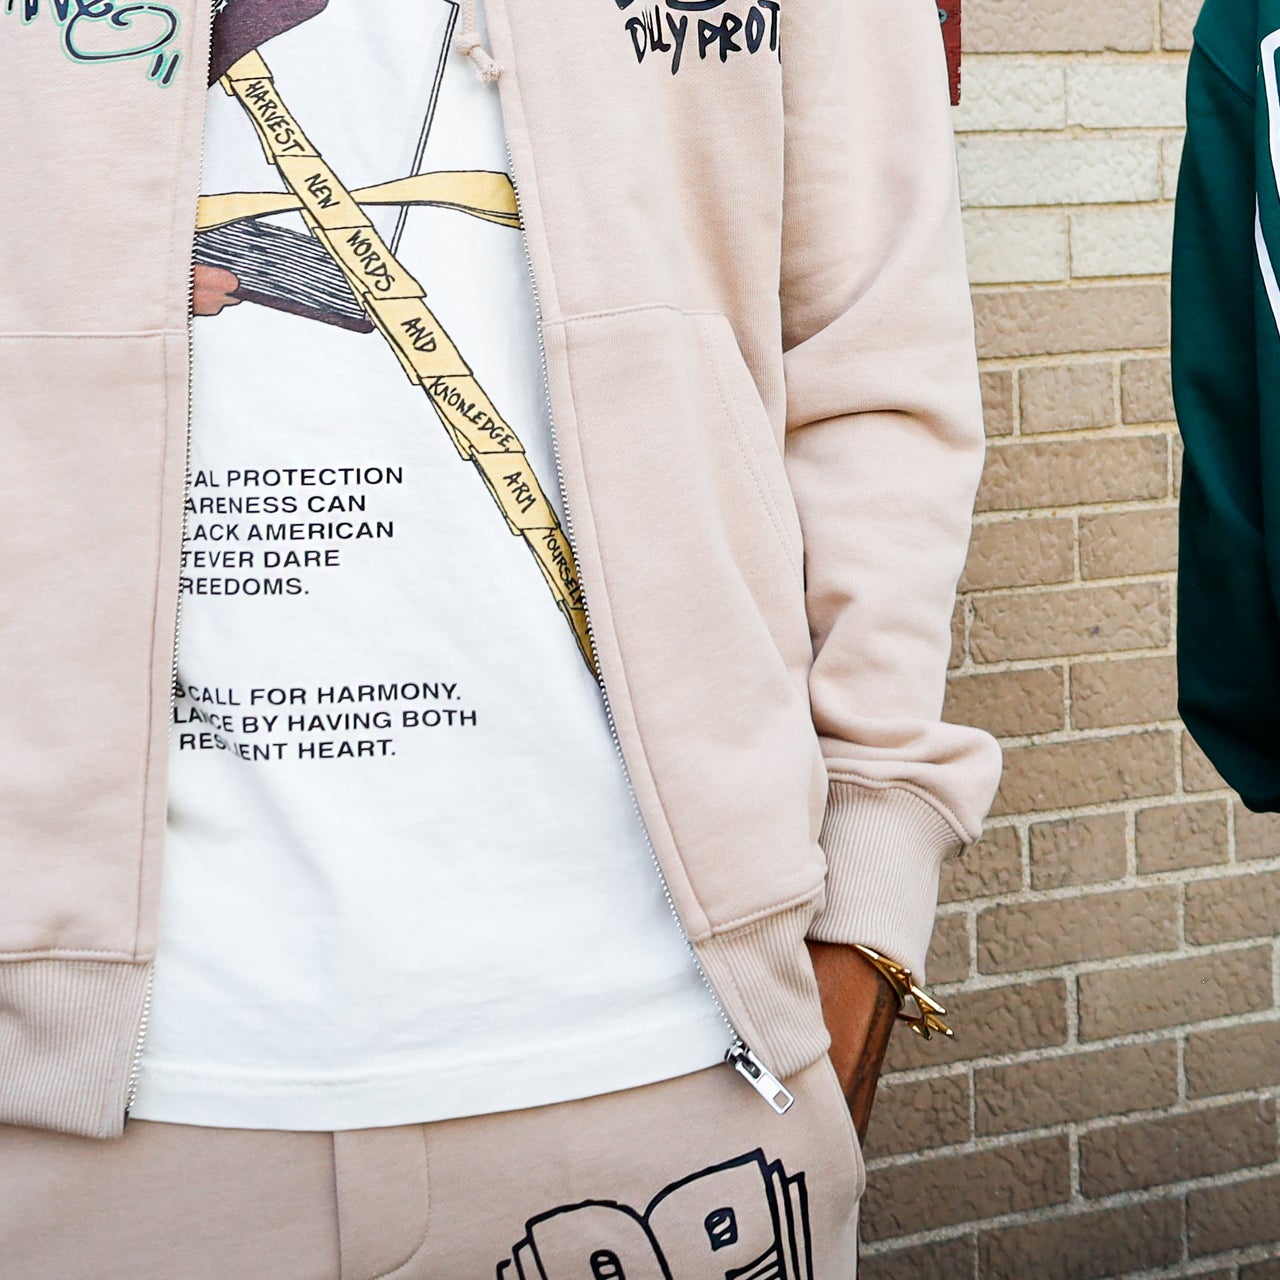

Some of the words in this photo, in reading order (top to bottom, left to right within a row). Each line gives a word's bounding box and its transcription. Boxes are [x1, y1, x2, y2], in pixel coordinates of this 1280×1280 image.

[245, 79, 306, 154] HARVEST
[304, 172, 341, 210] NEW
[346, 229, 397, 293] WORDS
[399, 315, 438, 355] AND
[193, 469, 221, 488] AL
[226, 466, 405, 488] PROTECTION
[307, 494, 367, 514] CAN
[501, 470, 537, 514] ARM
[246, 521, 395, 542] AMERICAN
[263, 549, 341, 569] DARE
[250, 687, 307, 707] FOR
[317, 682, 462, 704] HARMONY.
[242, 714, 280, 734] BY
[287, 710, 392, 732] HAVING
[401, 709, 478, 728] BOTH
[180, 732, 288, 761] RESENT
[298, 738, 397, 760] HEART.
